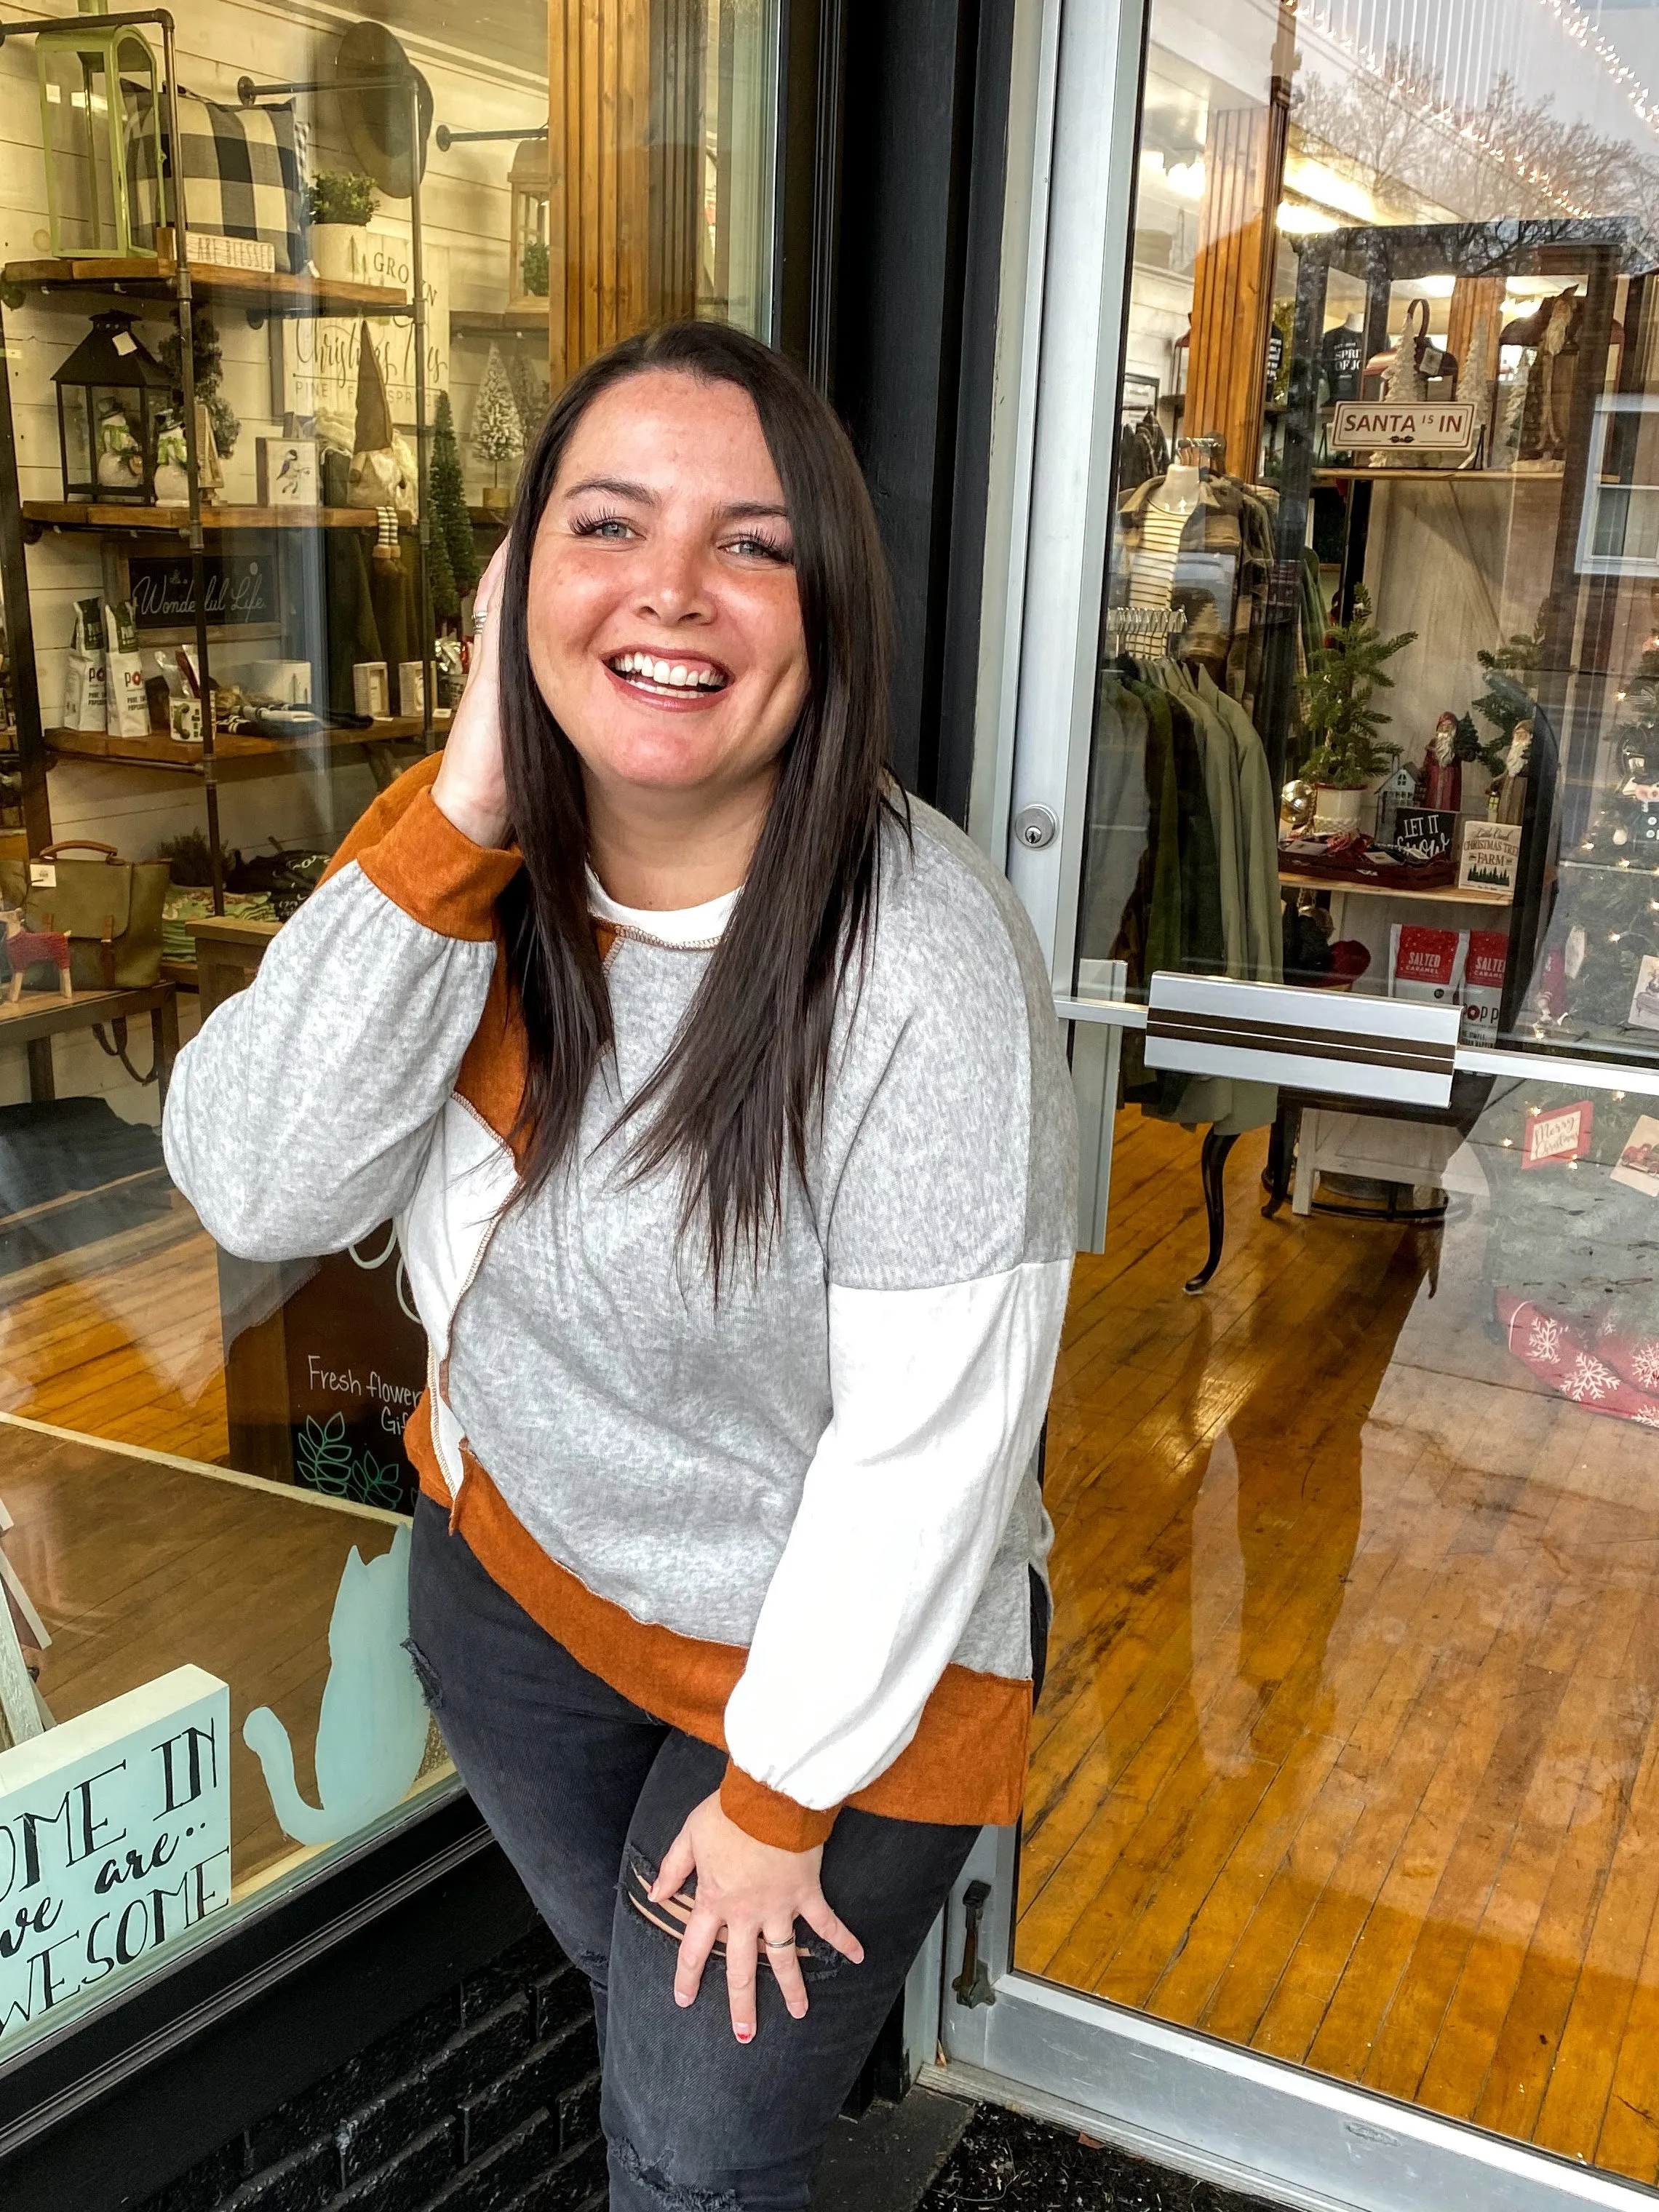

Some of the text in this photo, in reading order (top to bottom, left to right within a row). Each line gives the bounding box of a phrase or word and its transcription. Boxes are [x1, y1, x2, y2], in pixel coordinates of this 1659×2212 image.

[373, 252, 437, 306] GRON
[1344, 414, 1463, 433] SANTA IS IN
[1404, 814, 1440, 838] LET IT
[1464, 840, 1503, 853] CHRISTMAS
[1476, 851, 1505, 867] FARM
[1408, 951, 1441, 969] SALTED
[1405, 965, 1439, 975] CARAMEL
[307, 1355, 362, 1396] Fresh
[151, 1716, 218, 1821] IN
